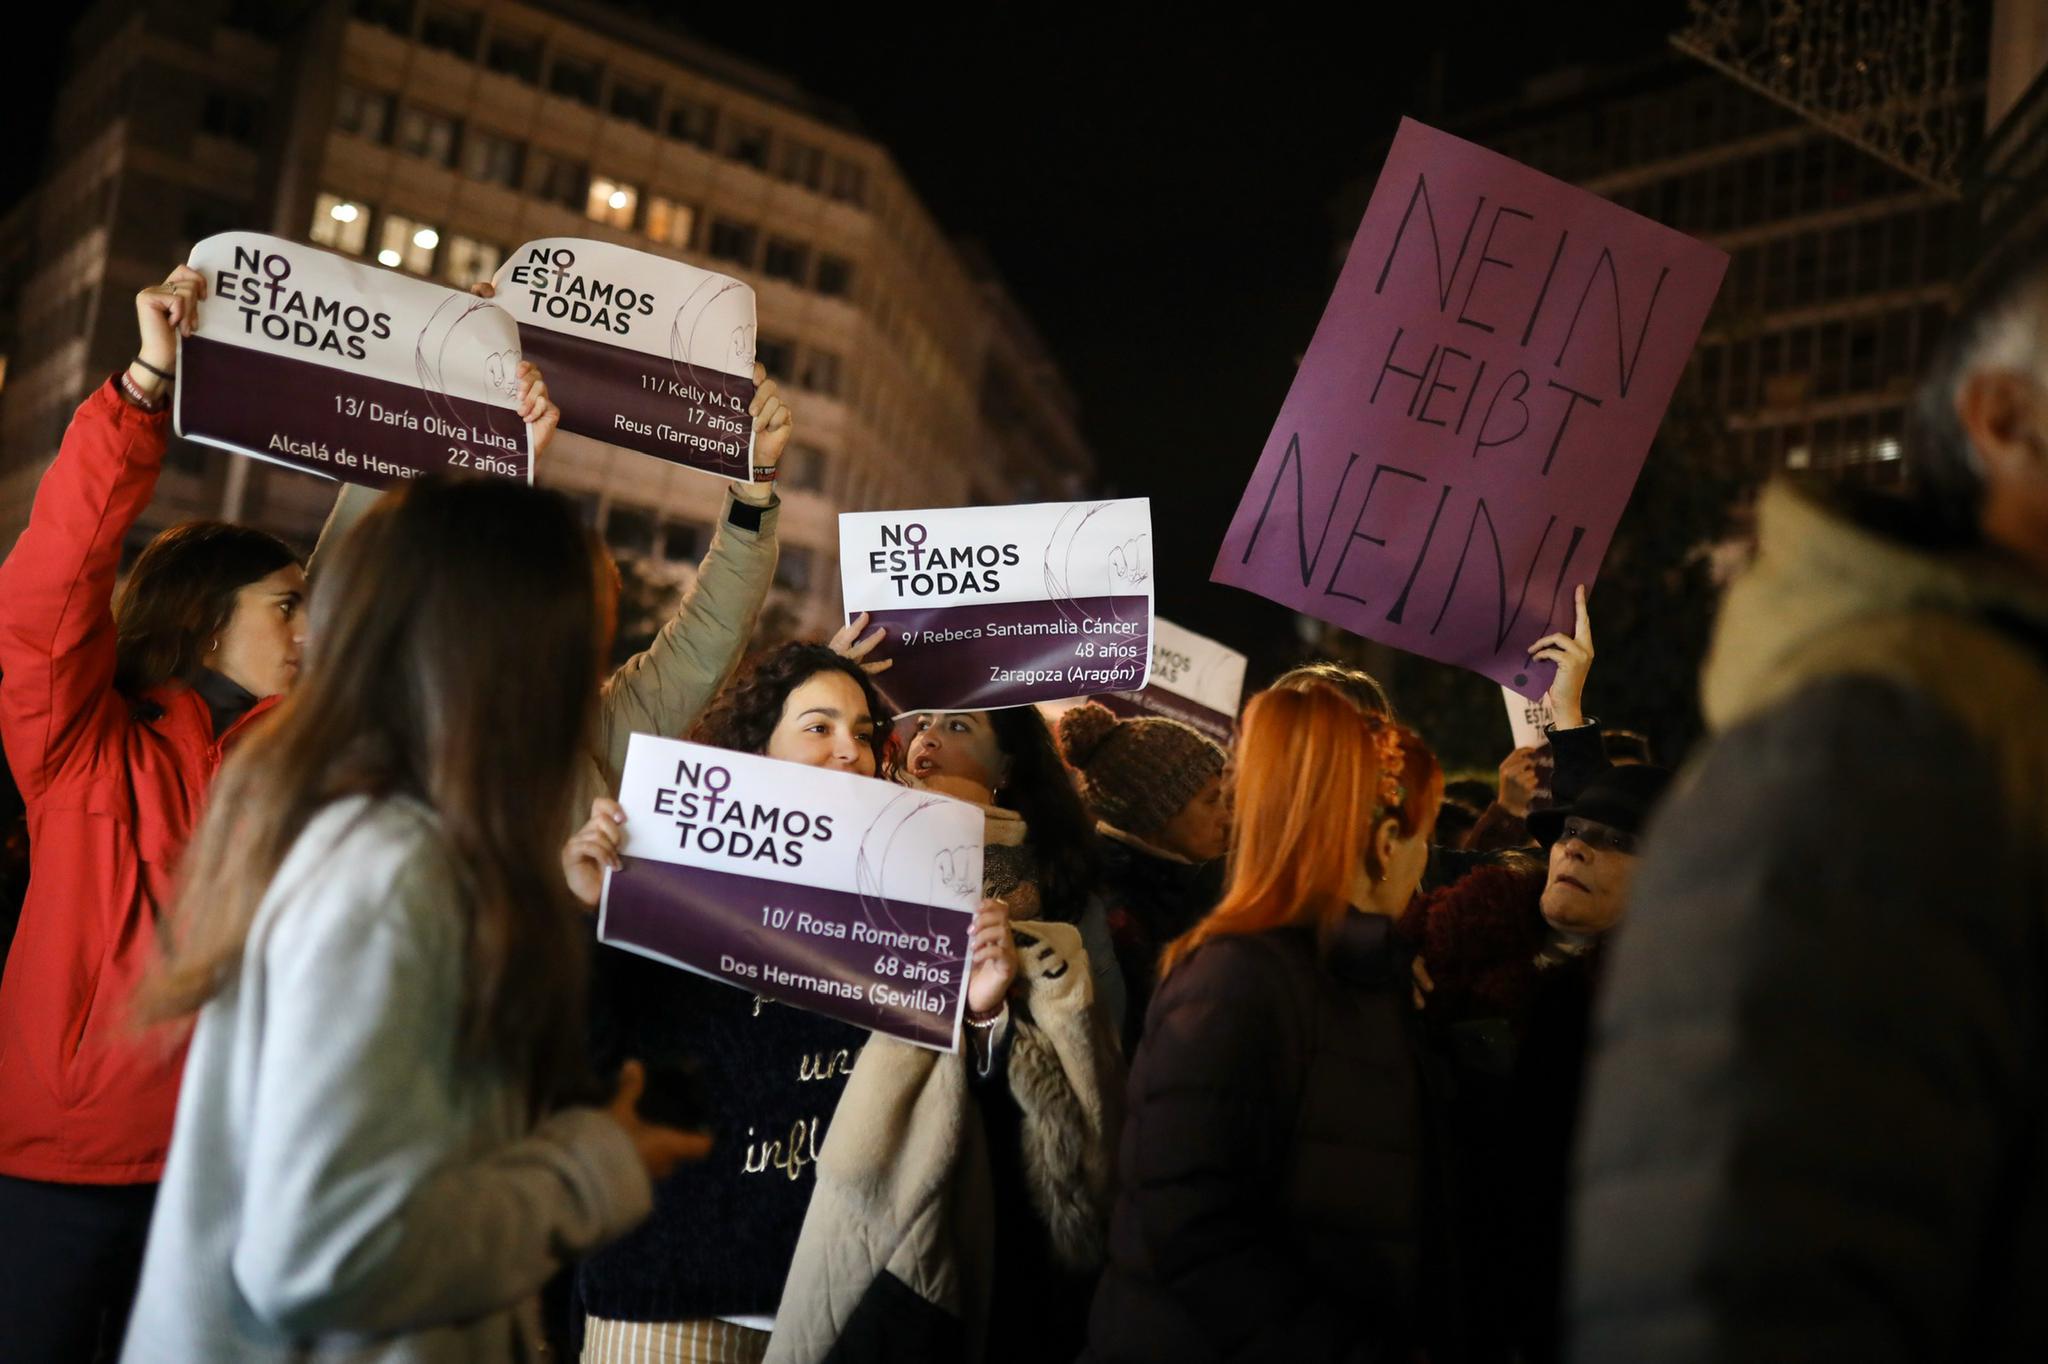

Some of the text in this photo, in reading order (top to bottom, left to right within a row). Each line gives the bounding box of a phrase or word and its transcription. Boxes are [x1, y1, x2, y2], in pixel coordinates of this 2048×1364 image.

[235, 246, 291, 282] NO
[528, 248, 575, 269] NO
[511, 266, 655, 316] ESTAMOS
[1374, 172, 1671, 399] NEIN
[215, 270, 392, 340] ESTAMOS
[529, 290, 630, 335] TODAS
[239, 306, 366, 360] TODAS
[641, 375, 665, 392] 11/
[668, 381, 705, 405] Kelly
[709, 391, 726, 407] M.
[335, 395, 517, 450] 13/ Daría Oliva Luna
[614, 414, 740, 457] Reus (Tarragona)
[688, 407, 743, 434] 17 años
[269, 434, 428, 479] Alcalá de Henar
[448, 448, 517, 477] 22 años
[881, 523, 927, 547] NO
[869, 543, 1020, 574] ESTAMOS
[890, 570, 1000, 597] TODAS
[901, 617, 1138, 646] 9/ Rebeca Santamalia Cáncer
[1075, 642, 1137, 658] 48 años
[990, 665, 1135, 684] Zaragoza (Aragón)
[674, 760, 731, 793] NO
[653, 787, 834, 841] ESTAMOS
[674, 821, 803, 866] TODAS
[761, 906, 954, 957] 10/ Rosa Romero R.
[720, 955, 946, 1015] Dos Hermanas (Sevilla)
[874, 956, 950, 984] 68 años
[798, 1048, 857, 1081] un
[741, 1115, 819, 1181] infl
